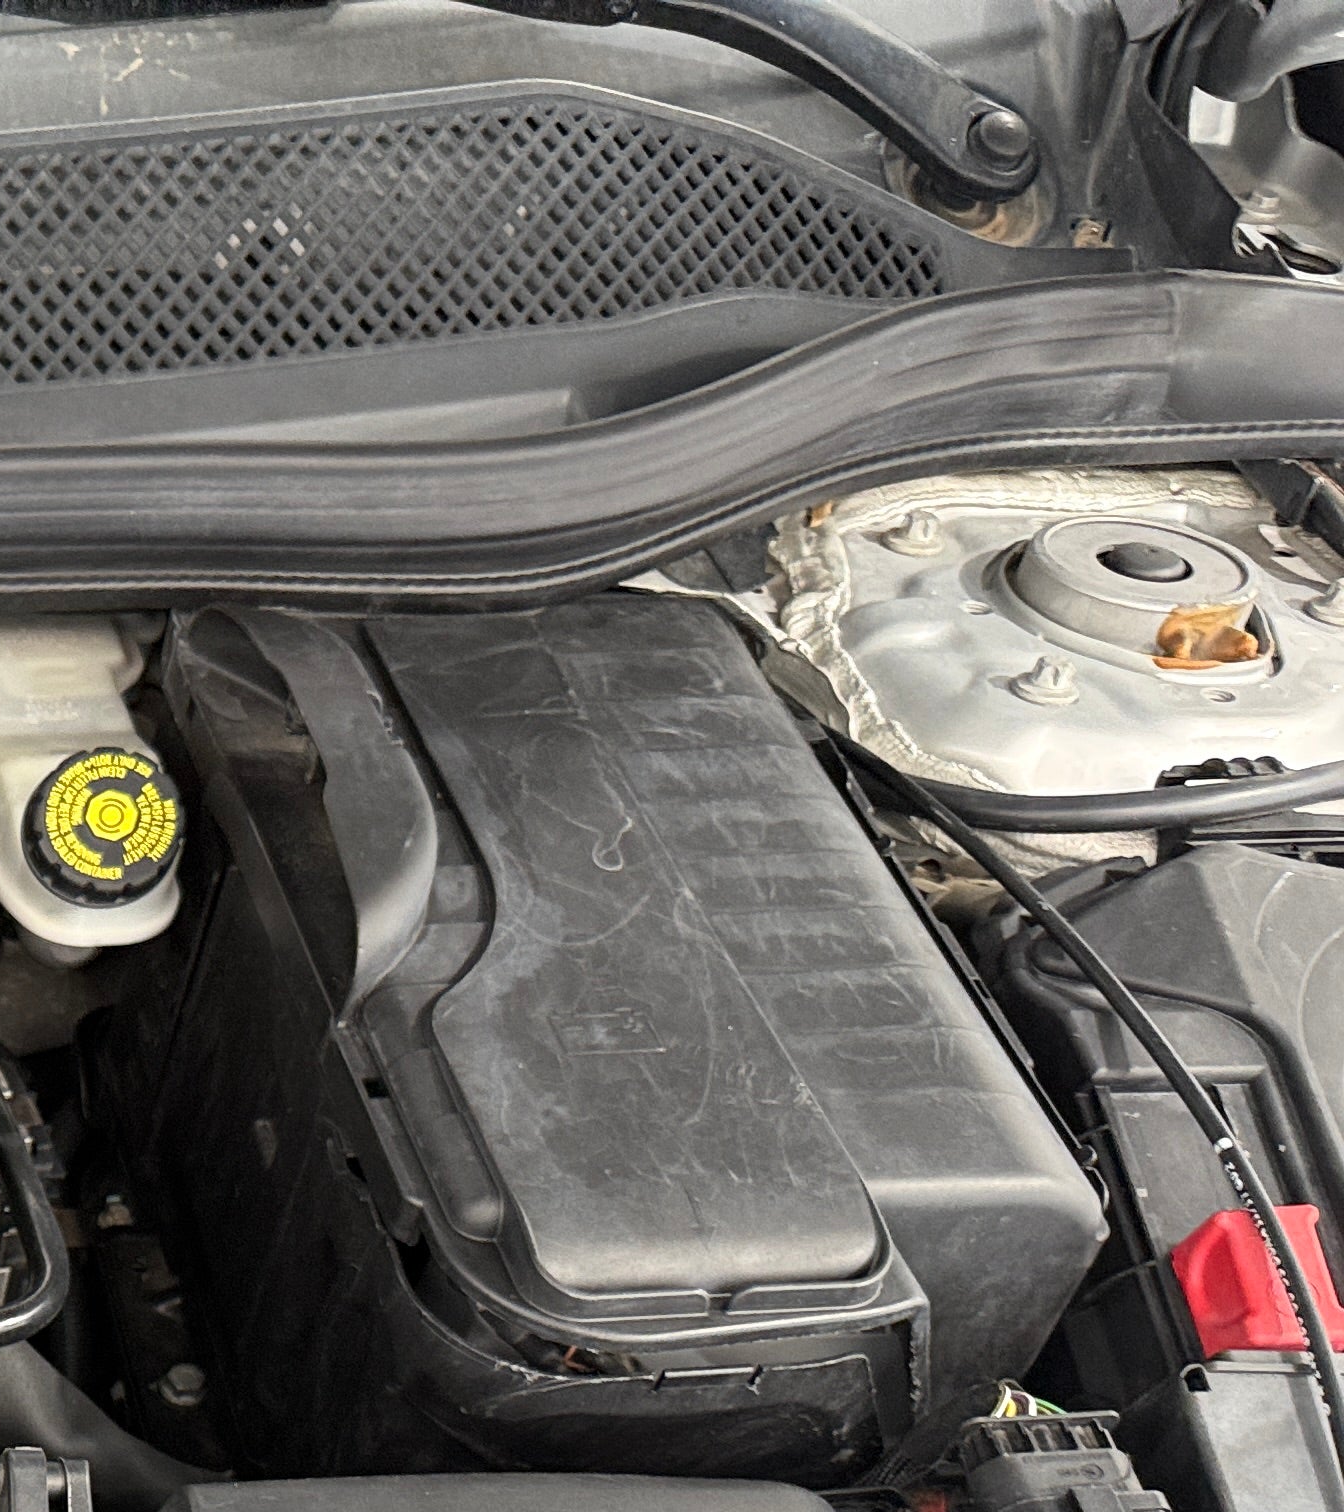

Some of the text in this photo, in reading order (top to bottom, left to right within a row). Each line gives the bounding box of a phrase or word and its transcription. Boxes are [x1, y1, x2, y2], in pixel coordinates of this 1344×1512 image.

[58, 761, 85, 783] BRAKE
[98, 767, 127, 779] CLEAN
[114, 755, 137, 770] ONLY
[135, 762, 153, 778] USE
[72, 769, 99, 790] FILLER
[47, 782, 66, 806] FLUID
[45, 806, 59, 830] FROM
[122, 794, 151, 851] VERWENDEN
[147, 799, 175, 863] NUR ORIGINAL
[51, 836, 76, 866] SEALED
[74, 859, 123, 880] CONTAINER
